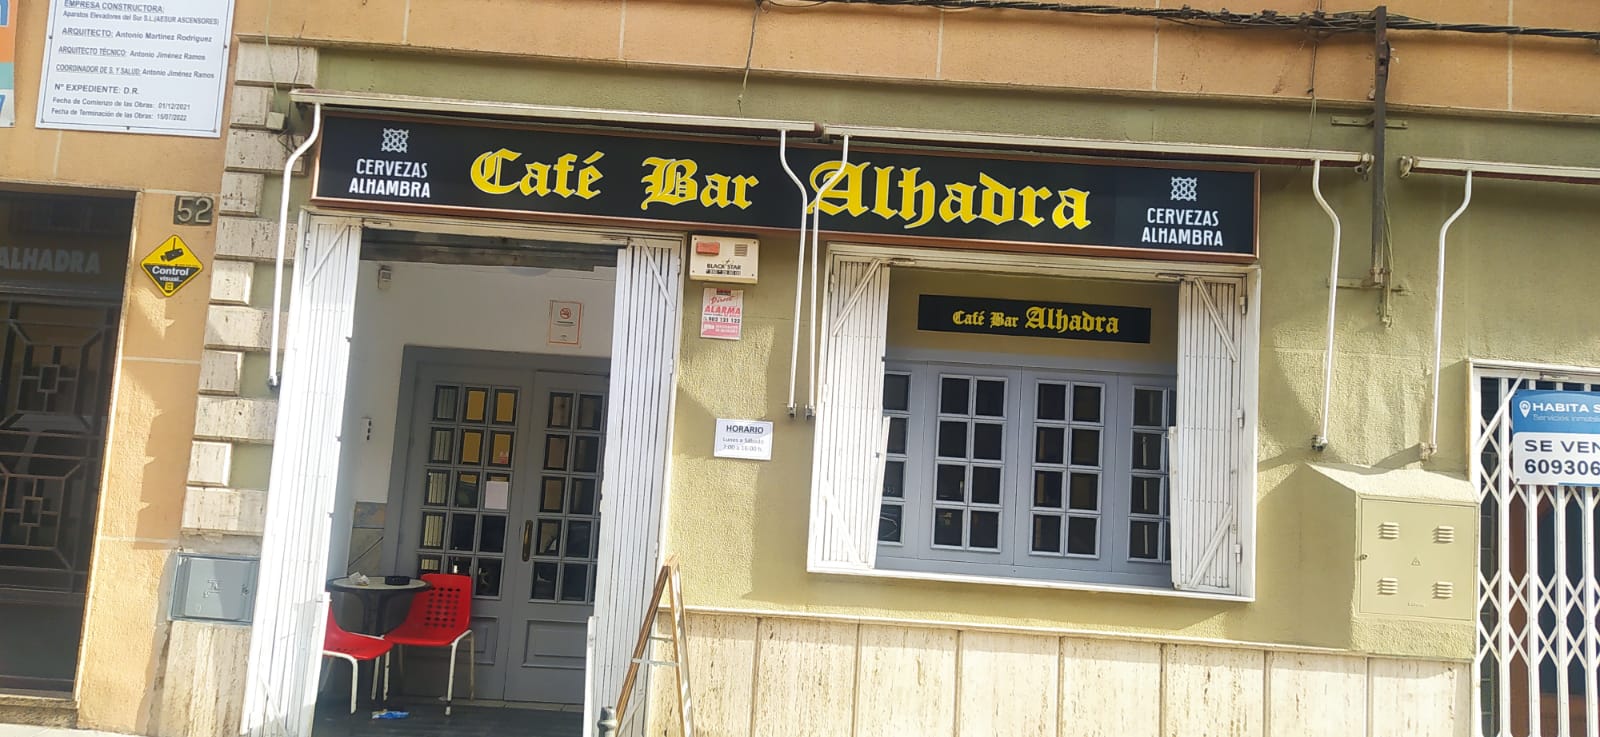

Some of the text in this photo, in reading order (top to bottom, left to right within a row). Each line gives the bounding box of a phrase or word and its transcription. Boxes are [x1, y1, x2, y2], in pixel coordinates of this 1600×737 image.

[64, 0, 164, 13] EMPRESA CONSTRUCTORA:
[63, 10, 88, 18] Aparatos
[90, 12, 121, 20] Elevadores
[62, 27, 113, 37] ARQUITECTO:
[115, 30, 143, 39] Antonio
[58, 45, 98, 55] ARQUITECTO
[130, 50, 155, 58] Antonio
[184, 53, 206, 61] Ramos
[56, 64, 99, 73] COORDINADOR
[100, 66, 108, 74] DE
[142, 68, 166, 76] Antonio
[193, 71, 214, 79] Ramos
[65, 83, 121, 94] EXPEDIENTE:
[52, 96, 71, 104] Fecha
[82, 98, 113, 107] Comienzo
[51, 107, 69, 115] Fecha
[355, 157, 429, 180] CERVEZAS
[348, 178, 432, 199] ALHAMBRA
[470, 147, 1092, 230] Café Bar Alhadra
[176, 197, 211, 223] 52
[1146, 207, 1220, 228] CERVEZAS
[1140, 226, 1224, 247] ALHAMBRA
[152, 265, 189, 276] Control
[704, 305, 741, 316] ALARMA
[952, 306, 1120, 334] Café Bar Alhadra
[1532, 402, 1590, 412] HABITA
[726, 425, 764, 434] HORARIO
[1525, 439, 1553, 452] SE
[1524, 458, 1600, 476] 609306
